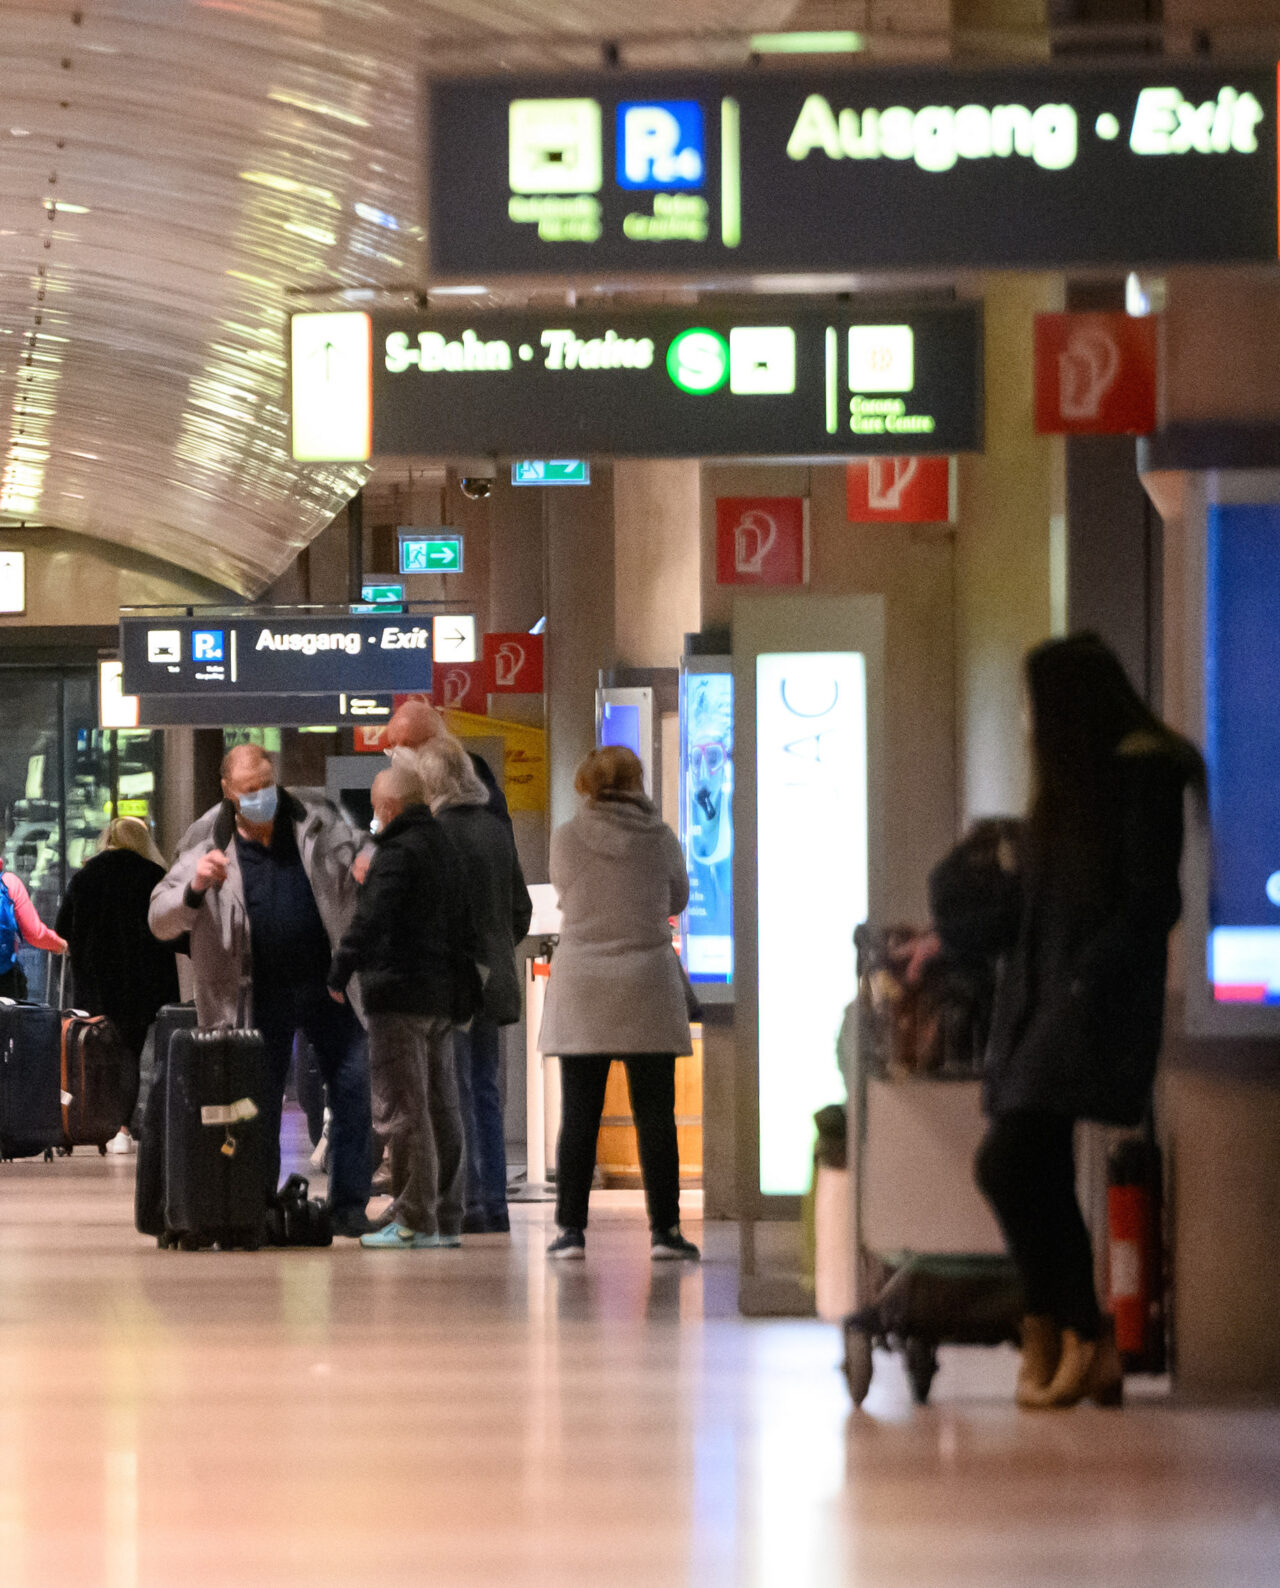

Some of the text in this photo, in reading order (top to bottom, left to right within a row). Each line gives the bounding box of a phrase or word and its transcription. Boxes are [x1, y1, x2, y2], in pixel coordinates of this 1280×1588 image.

[785, 85, 1265, 172] Ausgang Exit
[384, 328, 513, 373] S-Bahn
[677, 332, 728, 390] S
[255, 626, 429, 655] Ausgang Exit
